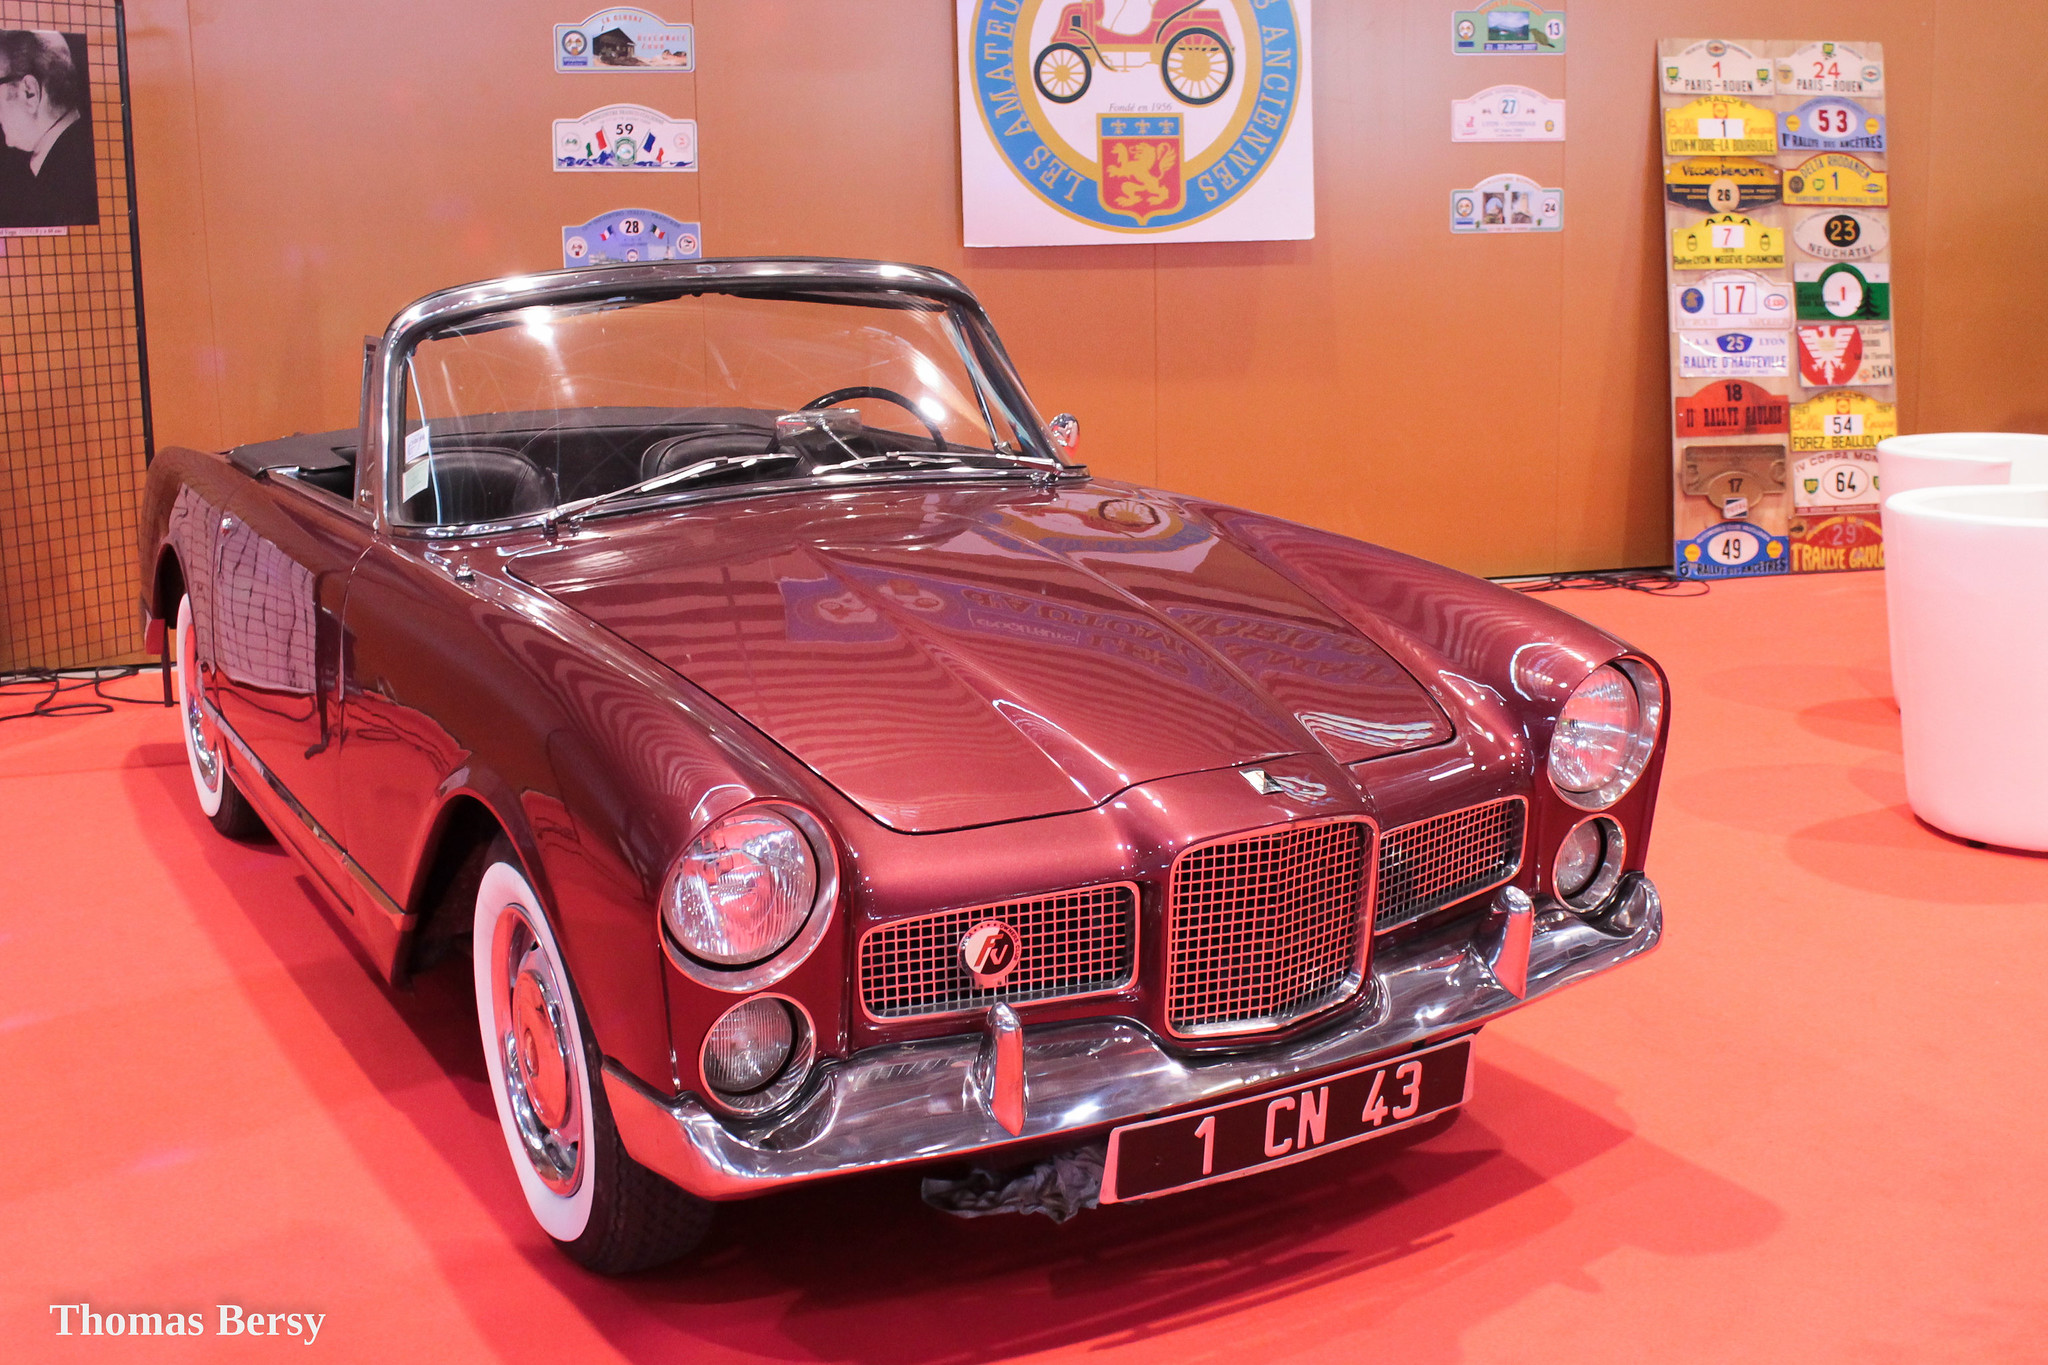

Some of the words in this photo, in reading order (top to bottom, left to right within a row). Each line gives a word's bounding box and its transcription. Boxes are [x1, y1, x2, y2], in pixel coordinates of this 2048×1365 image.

[1547, 22, 1561, 36] 13
[984, 0, 1033, 138] AMATEU
[1712, 61, 1721, 78] 1
[1813, 62, 1841, 79] 24
[1684, 79, 1712, 91] PARIS
[1723, 80, 1753, 92] ROUEN
[1796, 79, 1823, 91] PARIS
[1833, 80, 1863, 92] ROUEN
[1108, 102, 1135, 112] Fondé
[1150, 102, 1172, 112] 1956
[1197, 25, 1290, 202] ANCIENNES
[1502, 99, 1516, 114] 27
[616, 123, 634, 136] 59
[1721, 120, 1727, 137] 1
[1022, 145, 1086, 202] LES
[1799, 157, 1824, 178] DELTA
[1831, 172, 1839, 190] 1
[1717, 189, 1731, 201] 26
[1544, 203, 1556, 213] 24
[625, 220, 639, 234] 28
[1830, 220, 1856, 241] 23
[1723, 228, 1732, 246] 7
[1693, 256, 1710, 264] LYON
[1723, 285, 1745, 314] 17
[1840, 286, 1846, 301] 1
[1726, 336, 1744, 351] 25
[1759, 338, 1785, 346] LYON
[1683, 356, 1717, 369] RALLYE
[1722, 355, 1787, 369] D'HAUTEVILLE
[1725, 383, 1743, 402] 18
[1704, 407, 1739, 427] RALLYE
[1833, 416, 1853, 434] 54
[1793, 436, 1825, 449] FOREZ
[1795, 461, 1805, 473] IV
[1810, 451, 1849, 466] COPPA
[1854, 451, 1879, 463] MON
[1728, 478, 1744, 493] 17
[1836, 471, 1856, 492] 64
[1832, 524, 1857, 546] 29
[1722, 538, 1741, 560] 49
[1849, 542, 1885, 569] GAULO
[1698, 562, 1727, 576] RALLYE
[1194, 1115, 1216, 1175] 1
[1264, 1086, 1329, 1158] CN
[1361, 1060, 1423, 1127] 43
